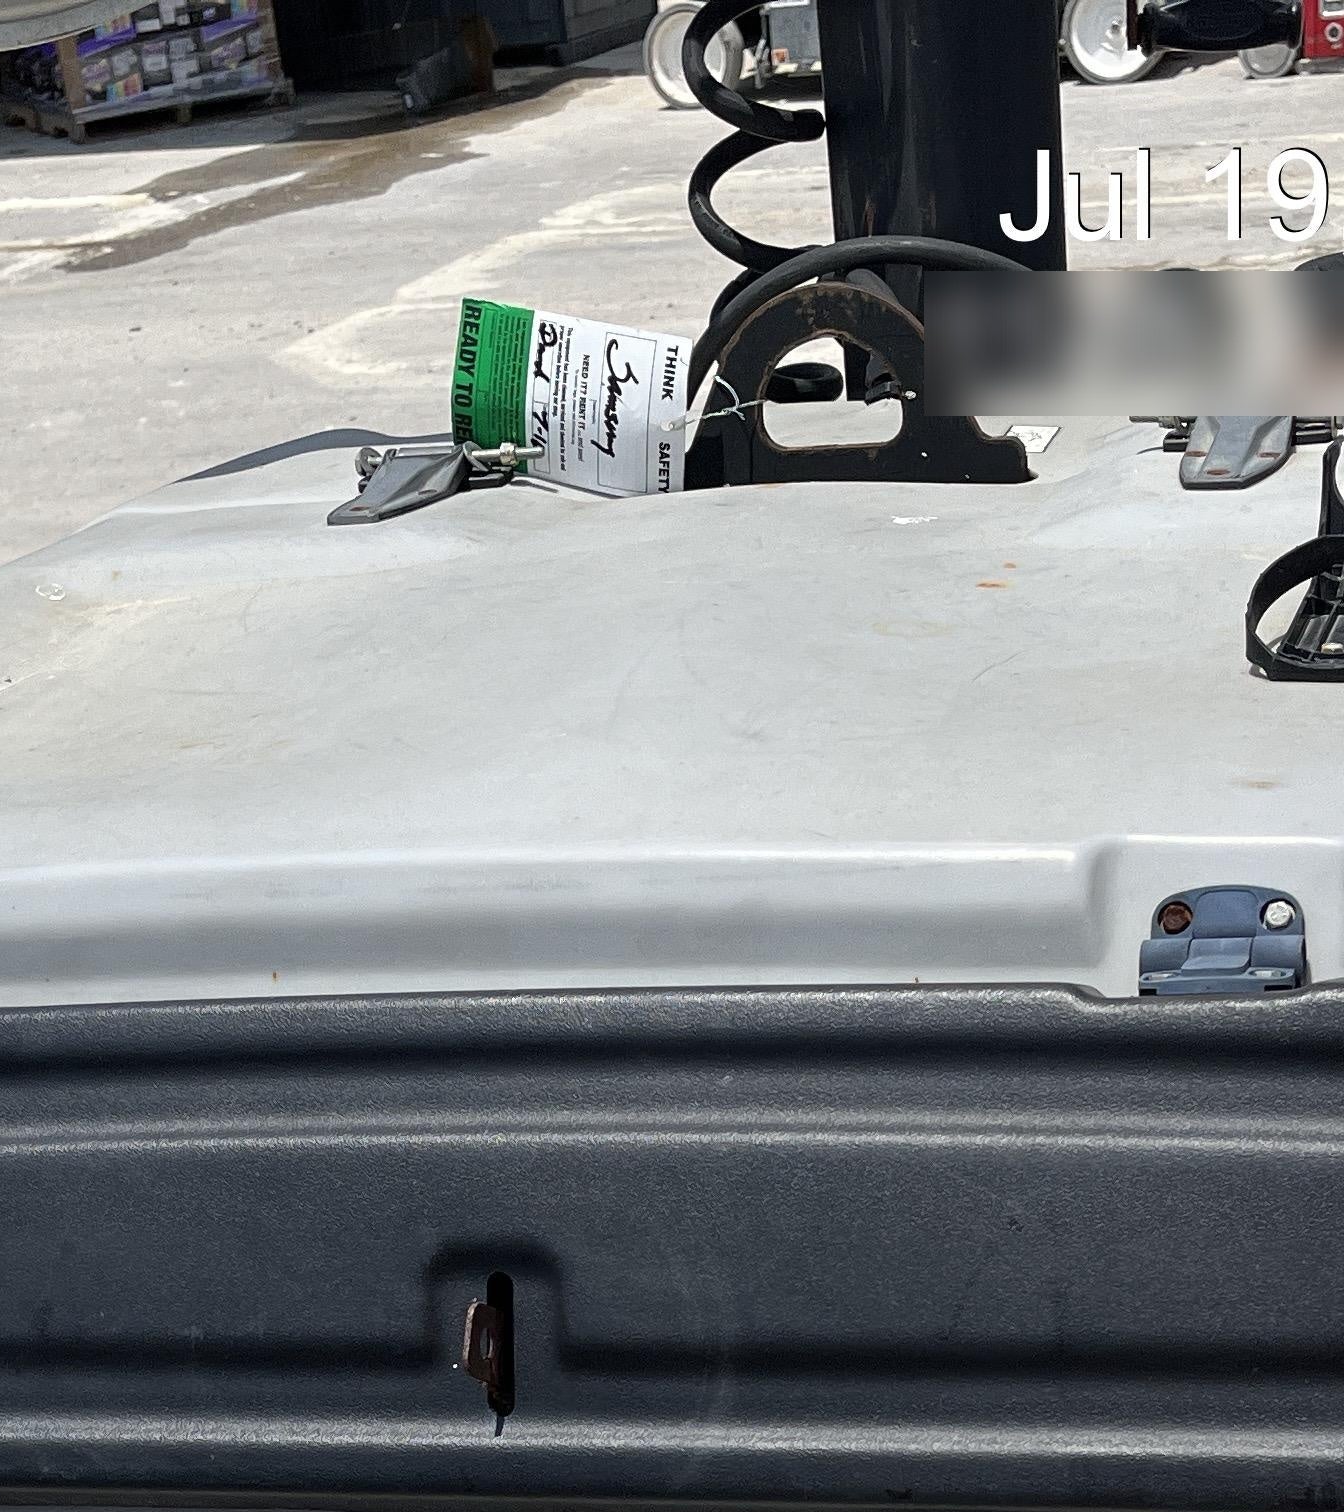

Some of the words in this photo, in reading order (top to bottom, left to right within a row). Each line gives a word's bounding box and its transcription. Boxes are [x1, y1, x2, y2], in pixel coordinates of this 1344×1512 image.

[457, 304, 482, 377] READY
[455, 383, 474, 410] TO
[661, 345, 680, 401] THINK
[656, 442, 671, 494] SAFETY
